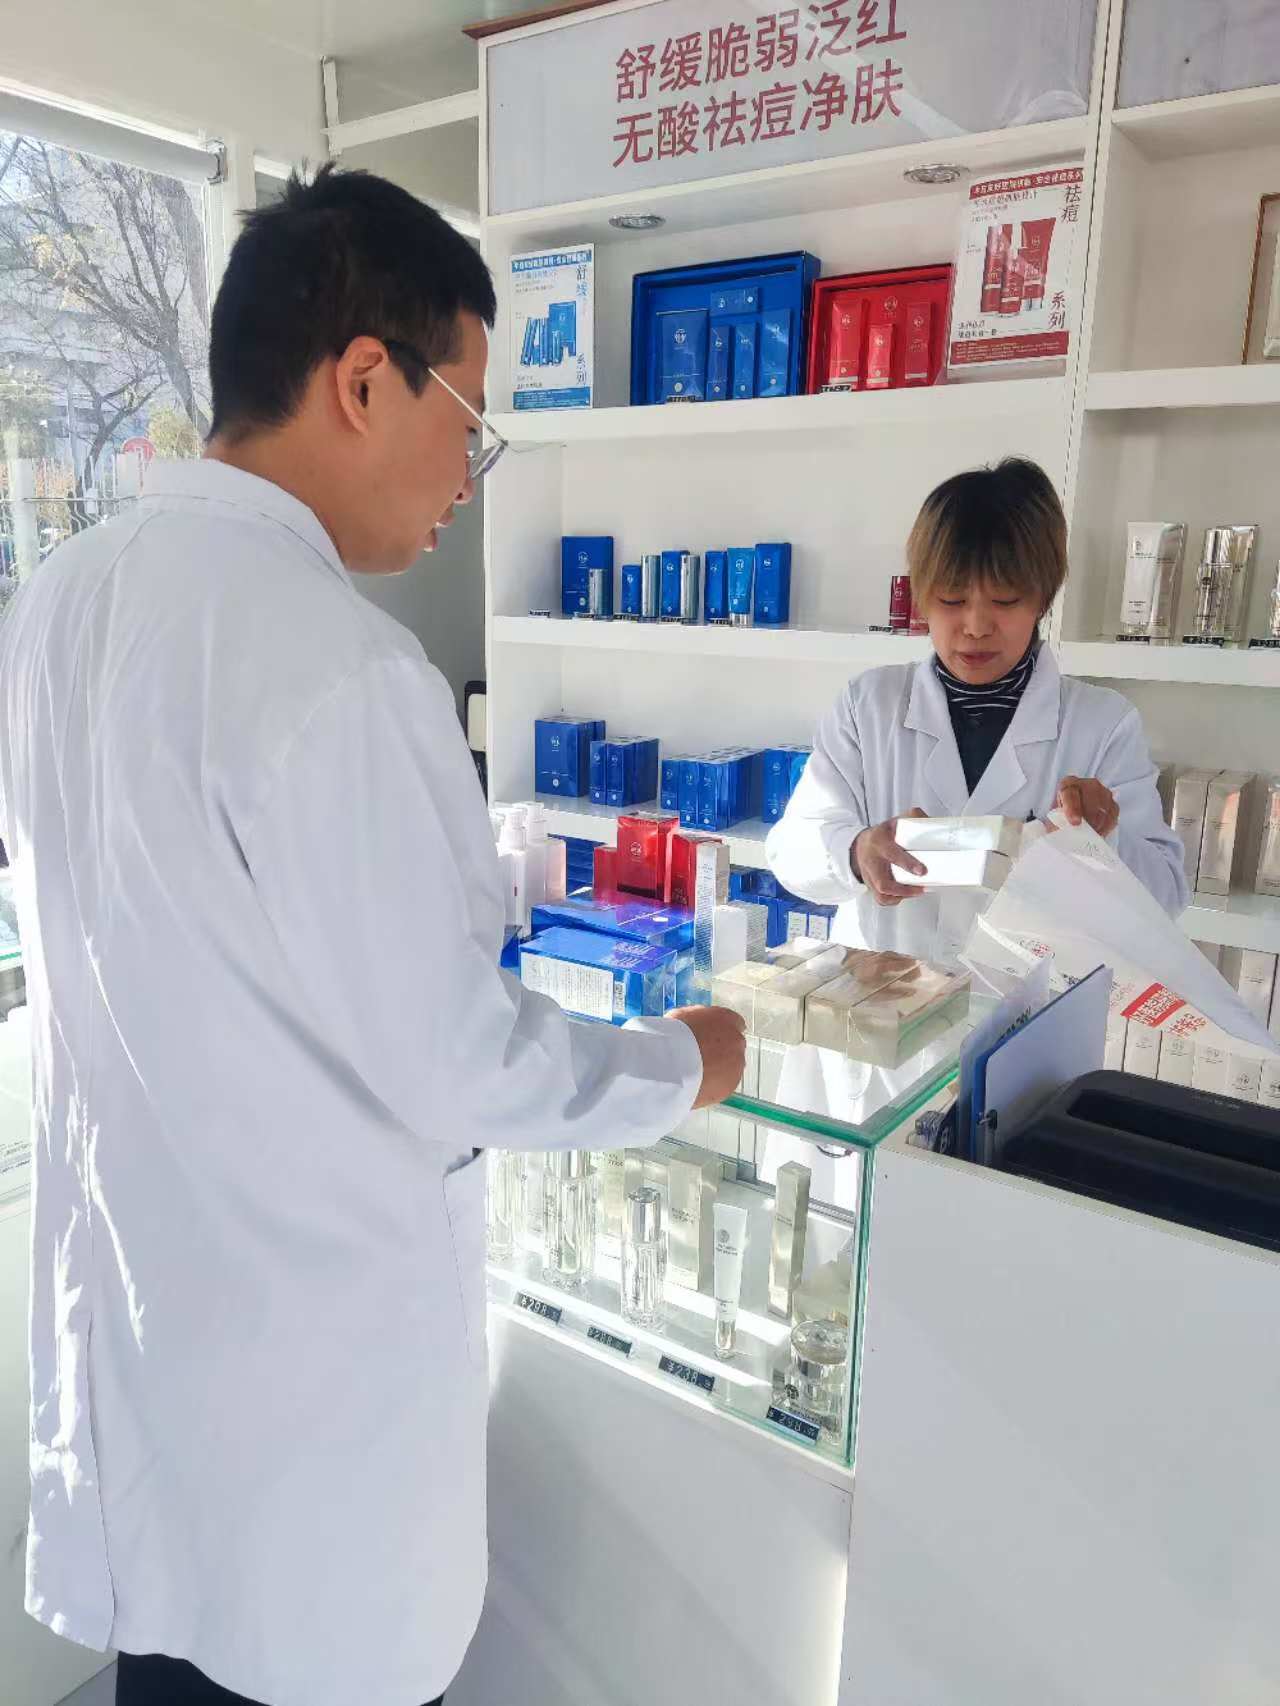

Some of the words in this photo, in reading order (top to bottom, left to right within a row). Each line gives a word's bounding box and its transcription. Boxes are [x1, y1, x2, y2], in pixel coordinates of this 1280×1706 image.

[615, 0, 907, 103] 舒缓脆弱泛红
[612, 58, 904, 168] 无酸祛痘净肤
[1048, 291, 1066, 330] 系列
